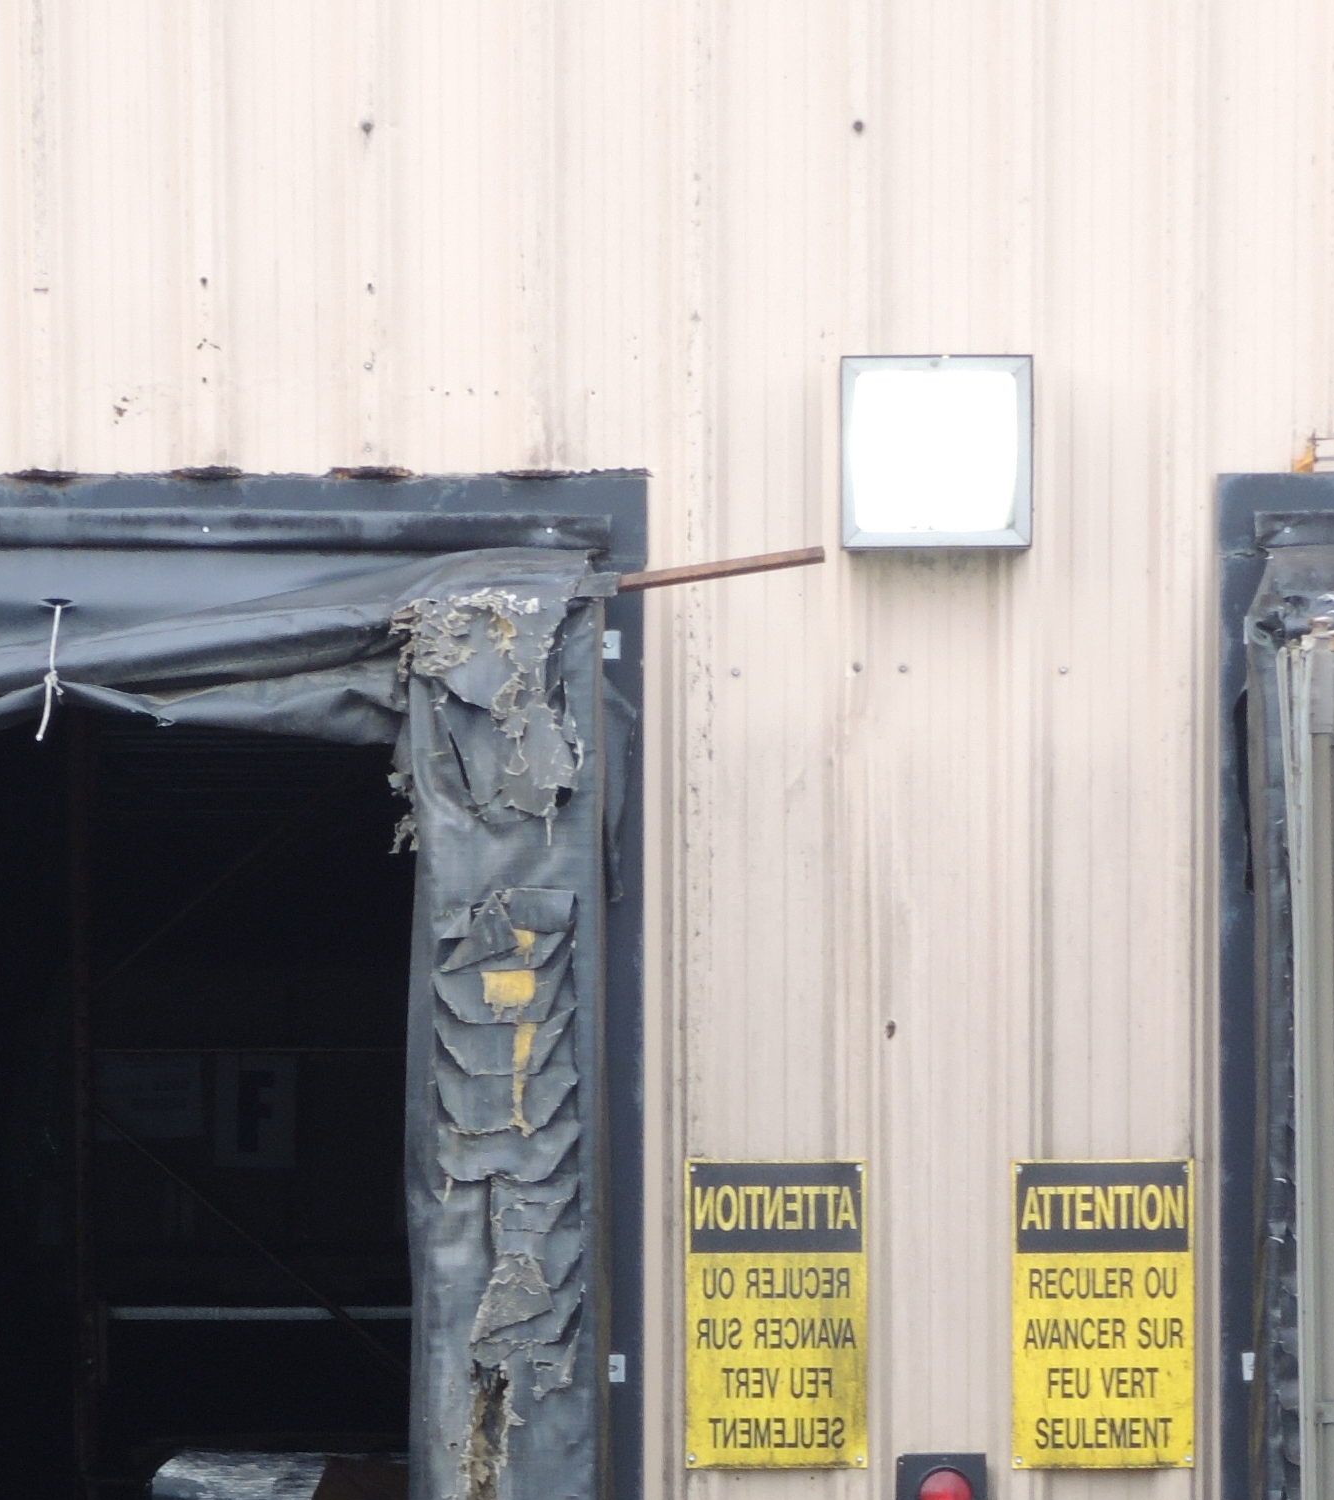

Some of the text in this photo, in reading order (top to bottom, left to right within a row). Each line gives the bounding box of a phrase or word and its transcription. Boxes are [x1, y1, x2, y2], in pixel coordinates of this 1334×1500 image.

[237, 1070, 274, 1152] F
[1021, 1183, 1184, 1231] ATTENTION
[1028, 1266, 1178, 1300] RECULER OU
[1023, 1316, 1185, 1350] AVANCER SUR
[1047, 1366, 1160, 1400] FEU VERT
[1034, 1417, 1173, 1450] SEULEMENT
